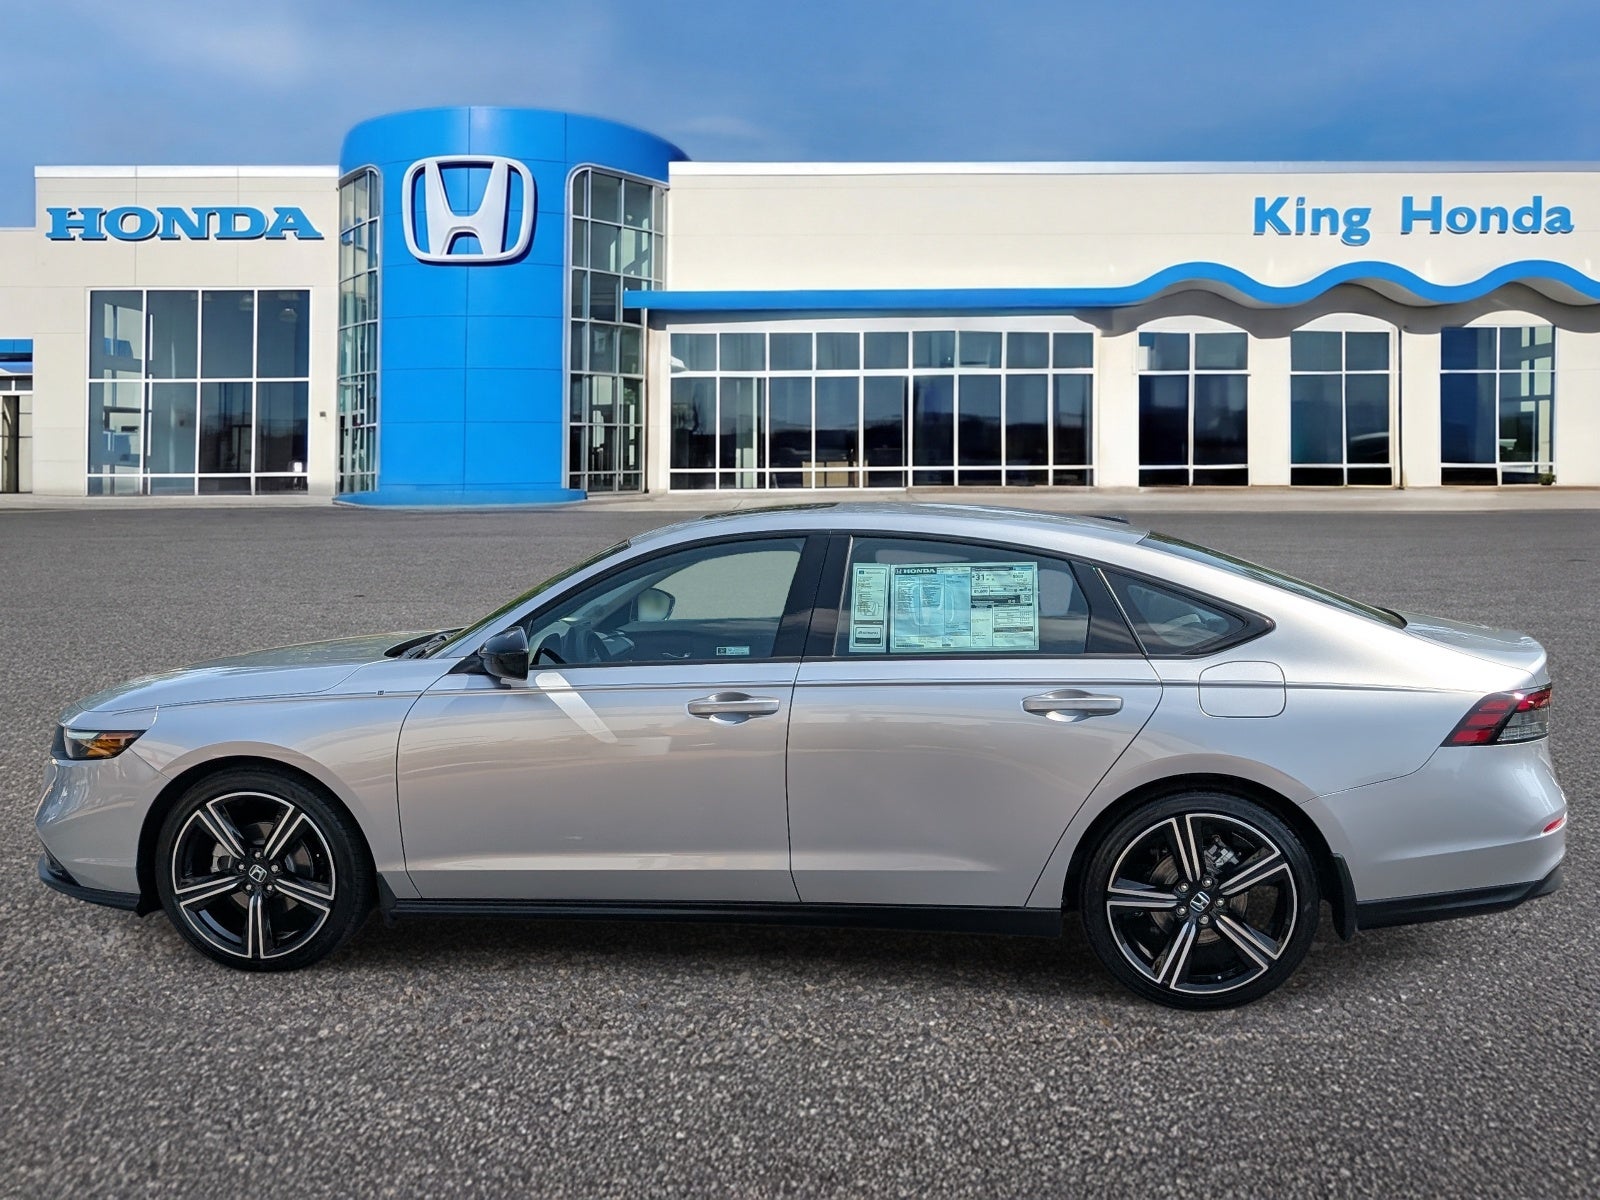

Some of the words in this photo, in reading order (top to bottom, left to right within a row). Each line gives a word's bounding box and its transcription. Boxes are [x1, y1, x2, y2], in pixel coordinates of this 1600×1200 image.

[46, 206, 324, 241] HONDA
[1253, 196, 1372, 246] King
[1400, 195, 1575, 235] Honda
